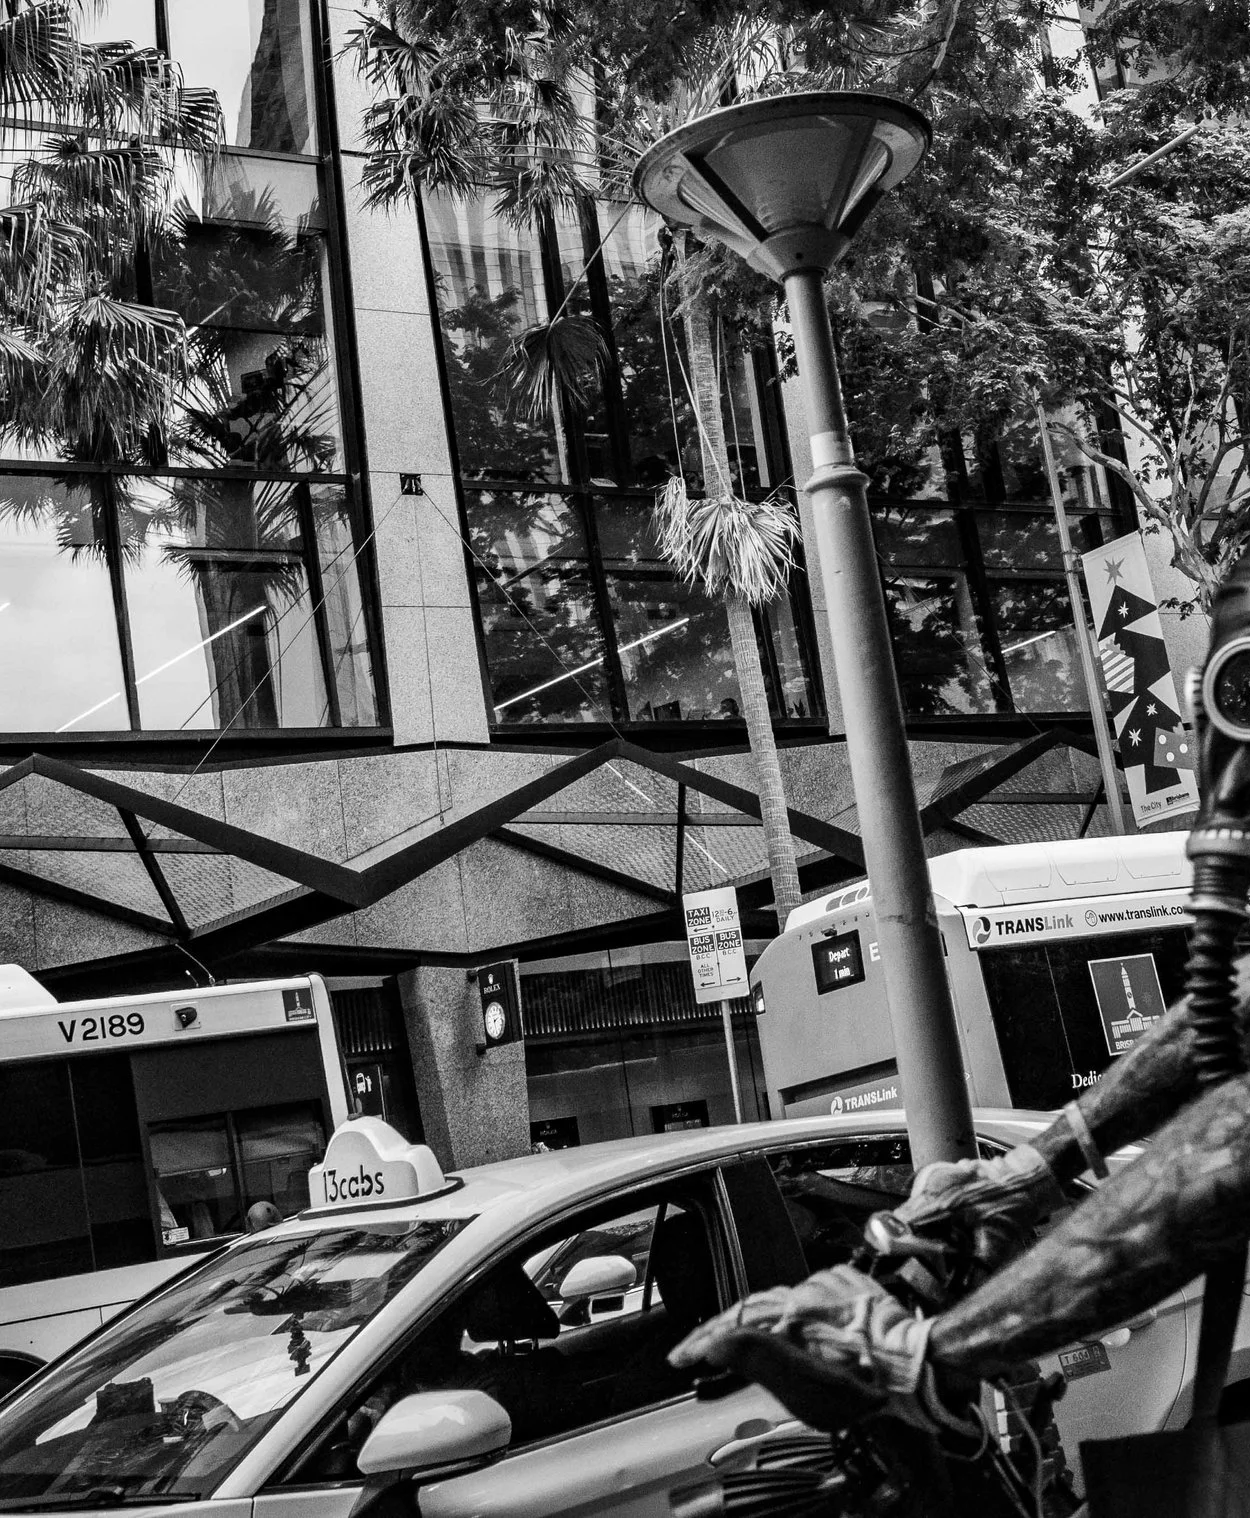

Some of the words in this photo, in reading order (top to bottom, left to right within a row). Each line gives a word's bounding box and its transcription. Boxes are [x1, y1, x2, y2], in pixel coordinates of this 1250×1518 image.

[1141, 805, 1151, 813] The
[1151, 801, 1162, 809] City
[688, 908, 709, 918] TAXI
[688, 917, 711, 927] ZONE
[996, 914, 1074, 936] TRANSLink
[1098, 904, 1184, 923] www.translink.co
[693, 936, 711, 946] BUS
[719, 931, 737, 941] BUS
[692, 944, 715, 955] ZONE
[718, 939, 741, 950] ZONE
[828, 947, 850, 963] Depart
[834, 968, 839, 980] 1
[57, 1012, 145, 1043] V2189
[844, 1086, 898, 1111] TRANSLink
[322, 1164, 385, 1203] 13cabs
